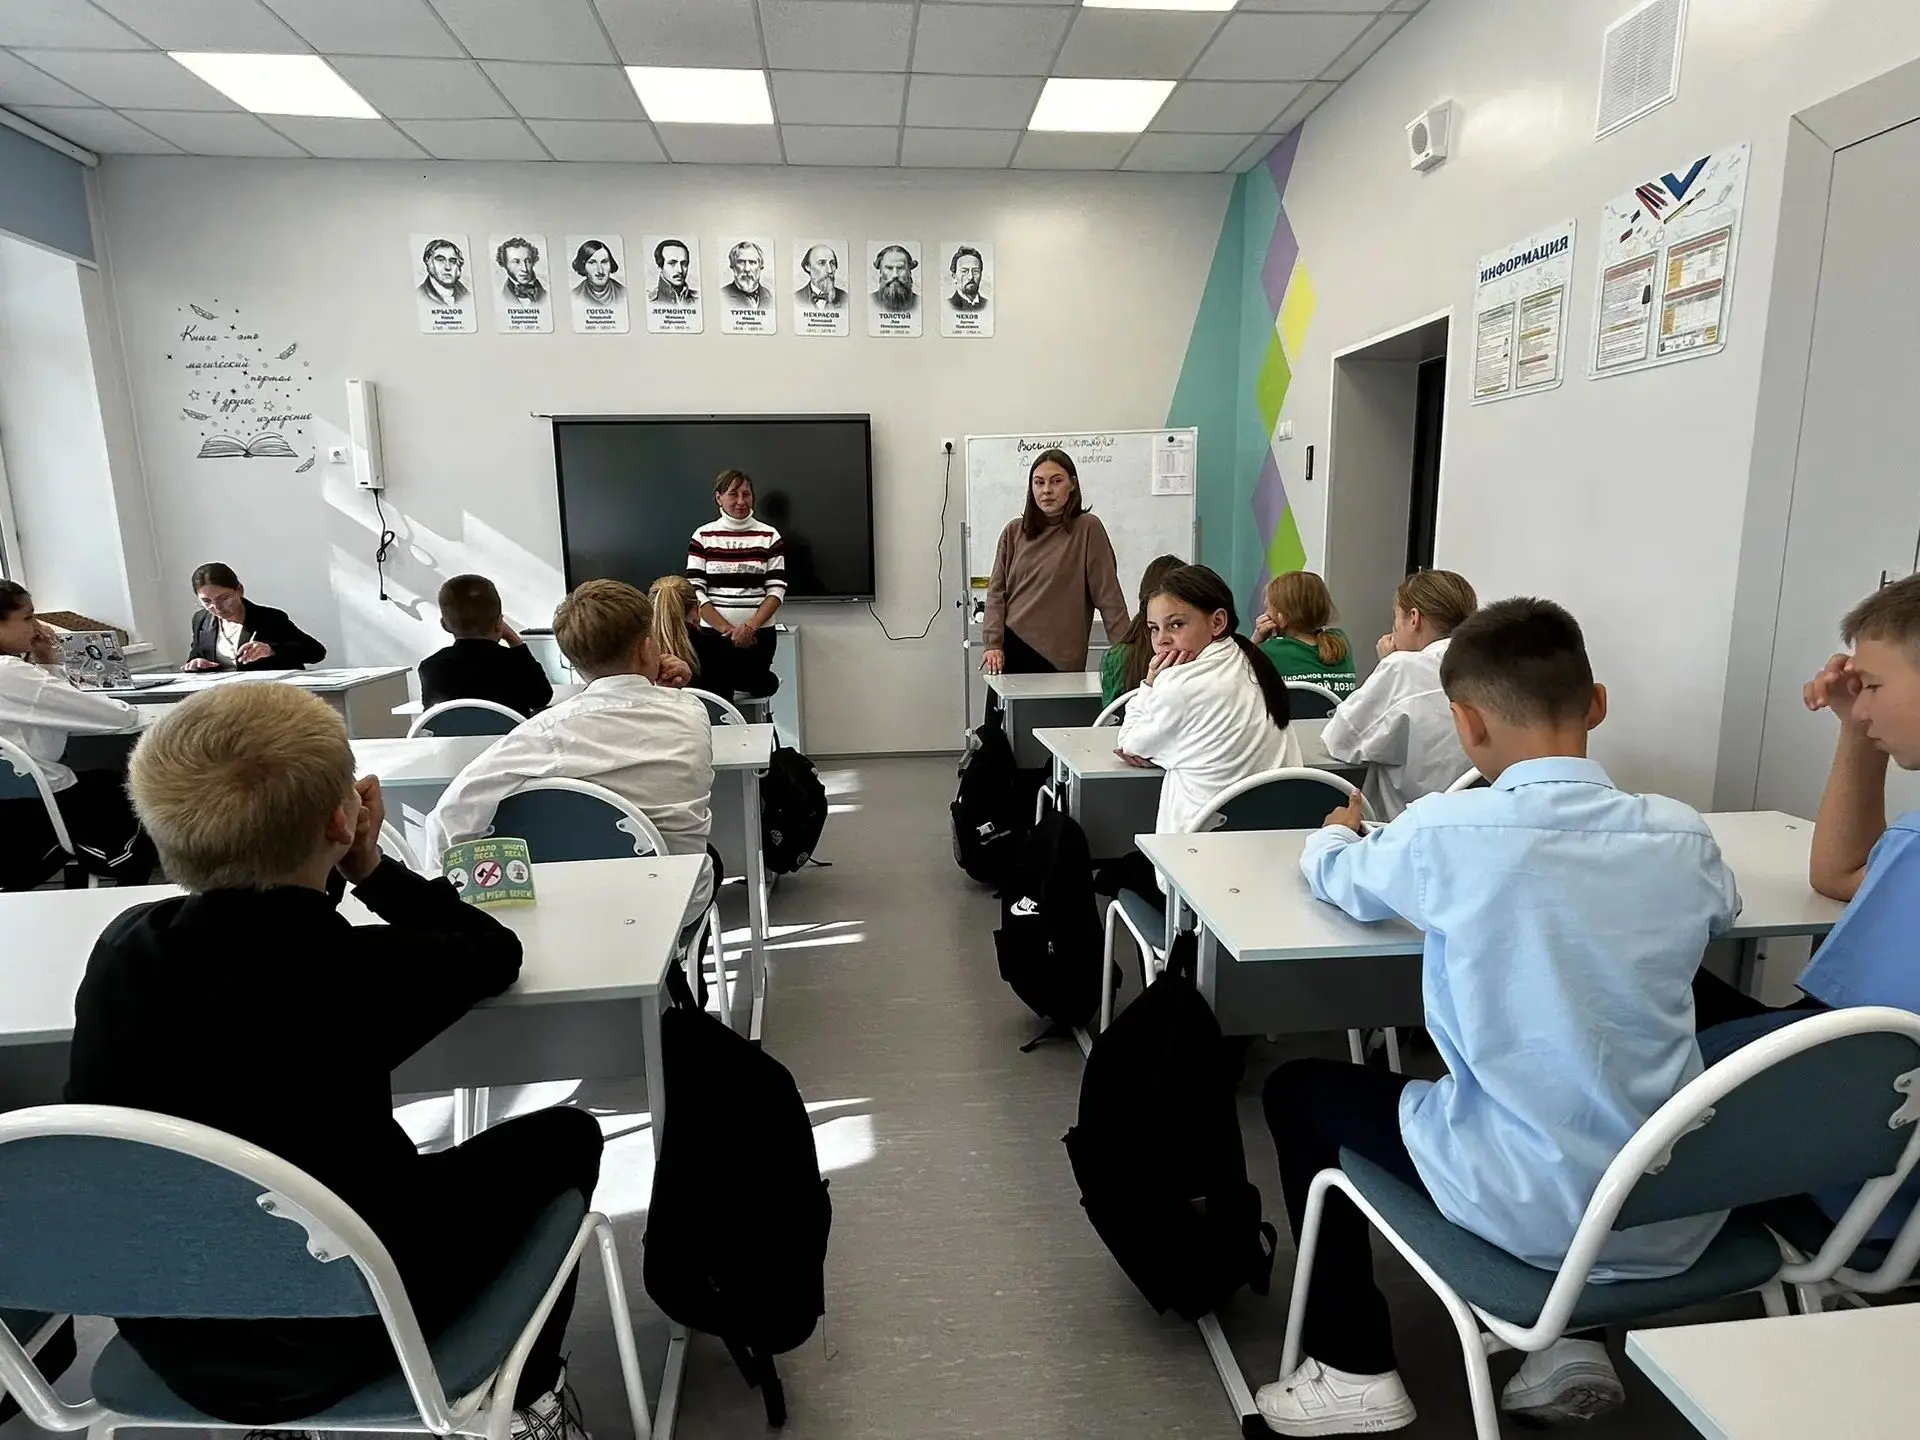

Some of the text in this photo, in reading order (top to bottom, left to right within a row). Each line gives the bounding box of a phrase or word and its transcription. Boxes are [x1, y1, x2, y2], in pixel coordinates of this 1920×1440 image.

[1480, 235, 1569, 283] ИНФОРМАЦИЯ
[879, 312, 911, 320] ТОЛСТОЙ
[181, 325, 218, 342] Книга
[237, 333, 260, 341] это
[185, 357, 251, 369] магический
[250, 375, 292, 389] портал
[211, 391, 255, 413] в другое
[256, 413, 313, 431] измерение
[1017, 439, 1064, 452] Восьмое
[474, 844, 497, 853] МАЛО
